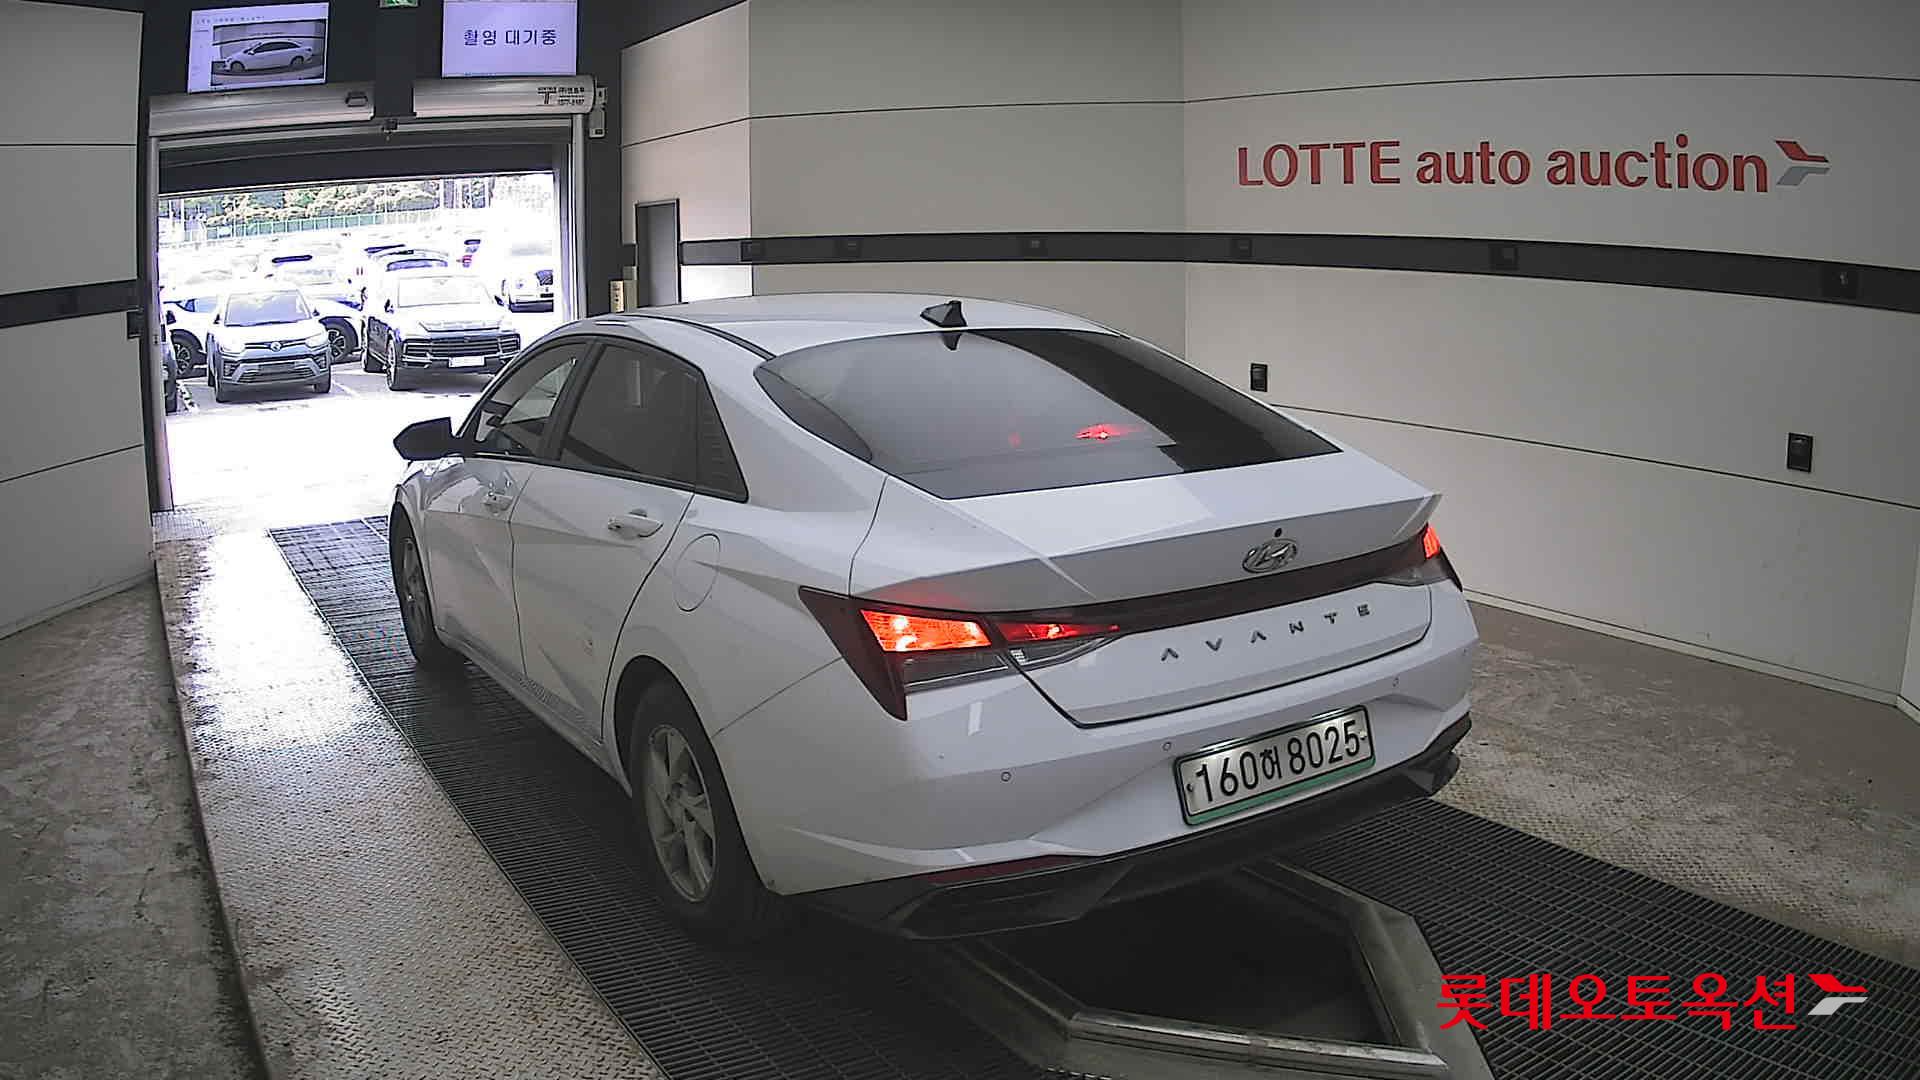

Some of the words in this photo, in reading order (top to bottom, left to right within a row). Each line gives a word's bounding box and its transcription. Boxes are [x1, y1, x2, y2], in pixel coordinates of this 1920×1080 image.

[505, 29, 557, 46] 대기중
[1238, 140, 1401, 187] LOTTE
[1416, 141, 1531, 185] auto
[1546, 133, 1768, 193] auction
[1161, 604, 1371, 662] AVANTE
